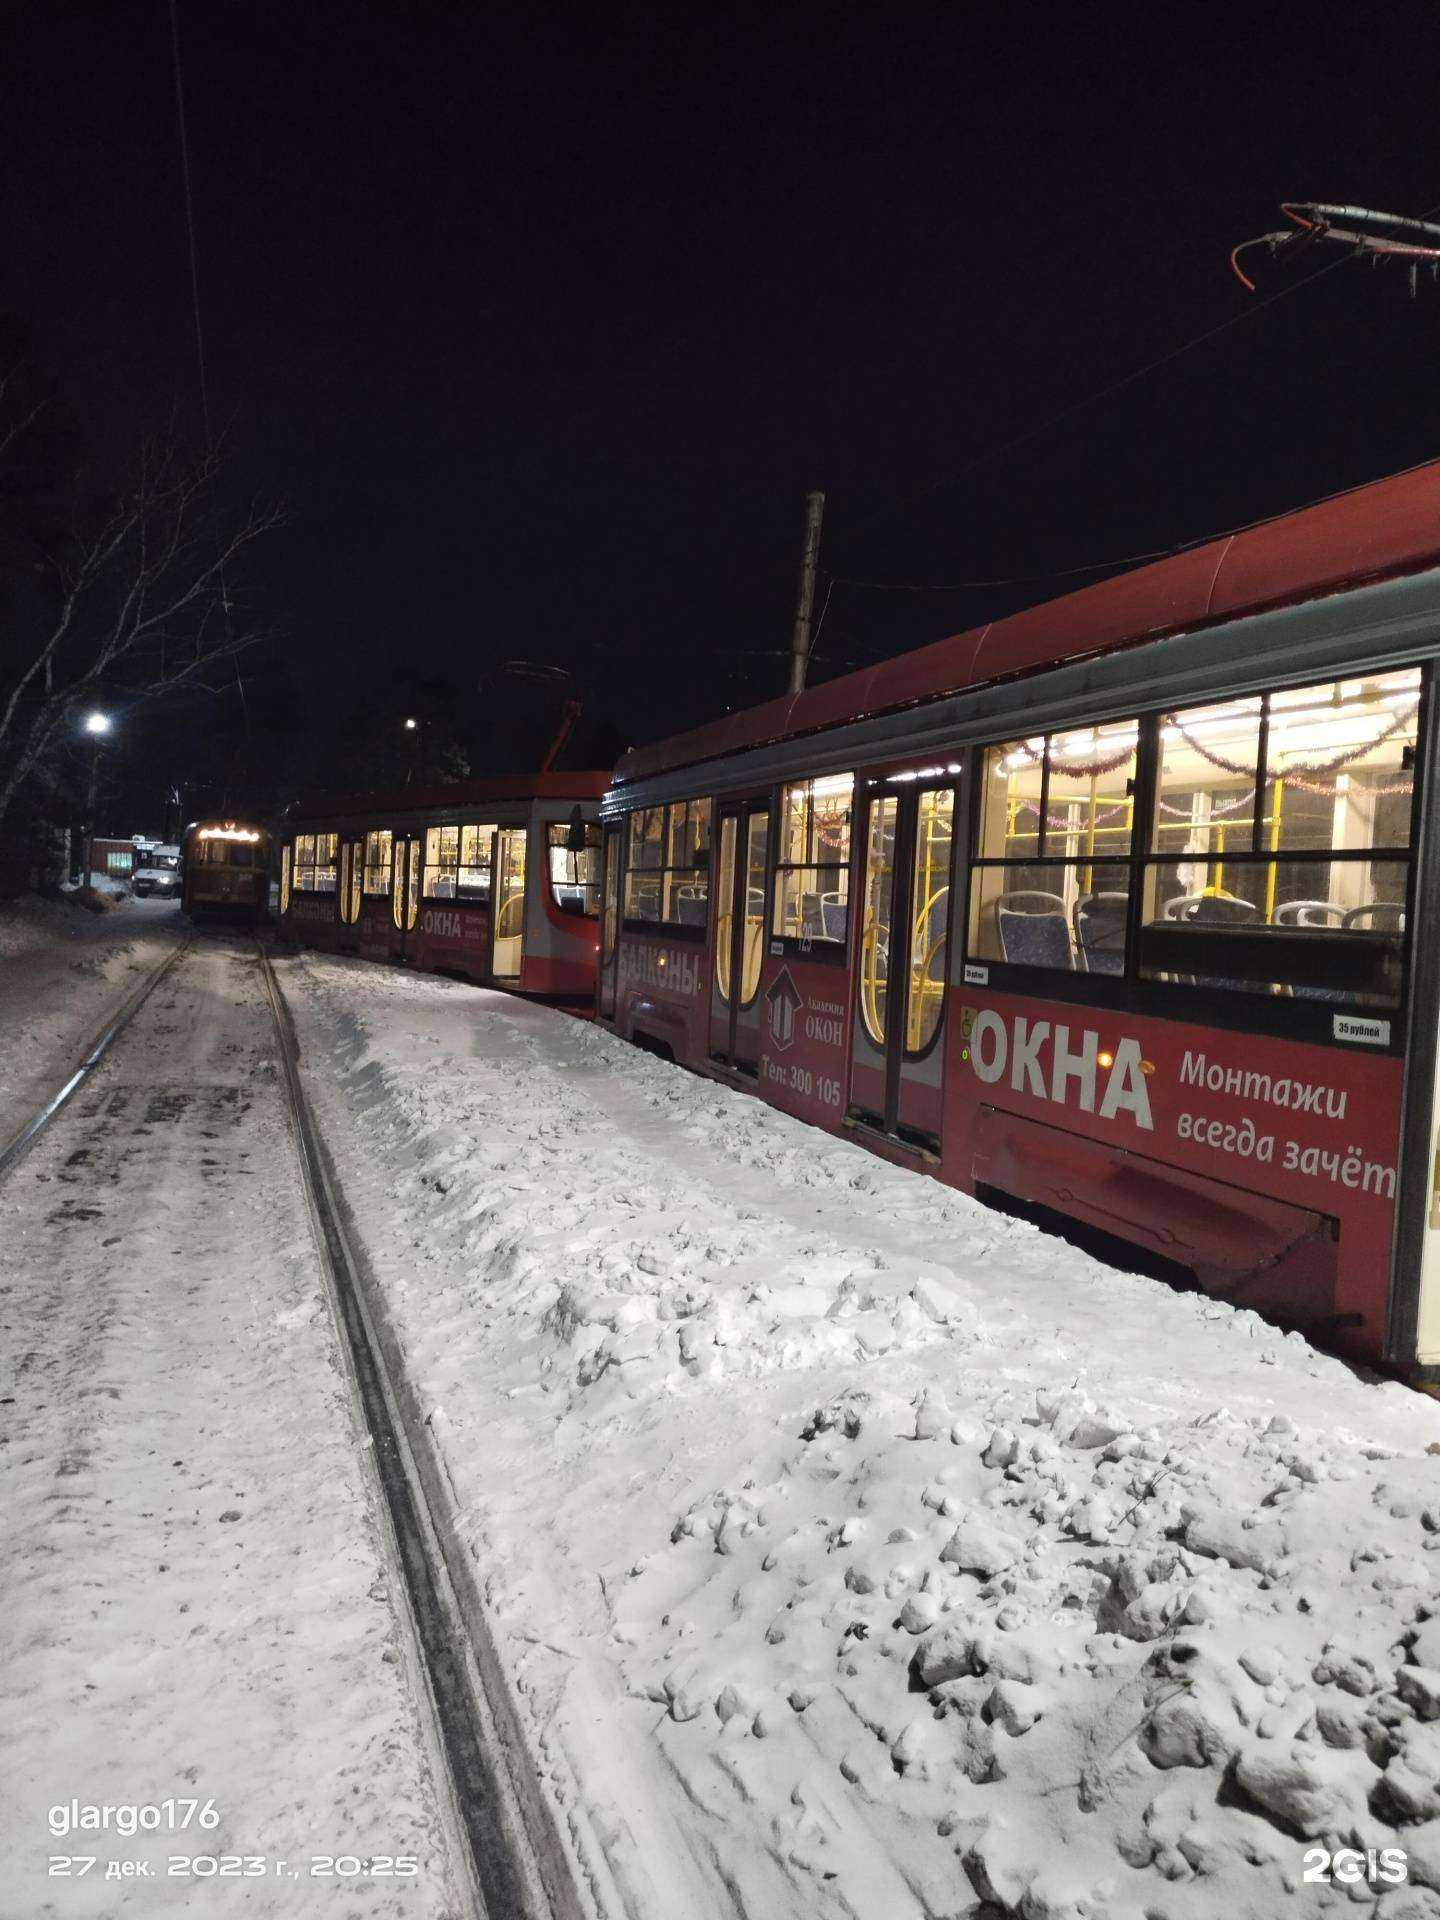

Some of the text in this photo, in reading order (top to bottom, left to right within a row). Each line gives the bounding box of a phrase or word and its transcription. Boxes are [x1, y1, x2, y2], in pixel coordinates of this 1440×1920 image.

[424, 911, 461, 937] ОКНА
[805, 1016, 843, 1046] ОКОН
[1338, 1022, 1349, 1034] 35
[790, 1066, 812, 1096] 300
[816, 1076, 841, 1106] 105
[970, 1009, 1155, 1132] ОКНА
[1179, 1050, 1348, 1120] Монтажи
[1177, 1113, 1397, 1200] всегда зачёт
